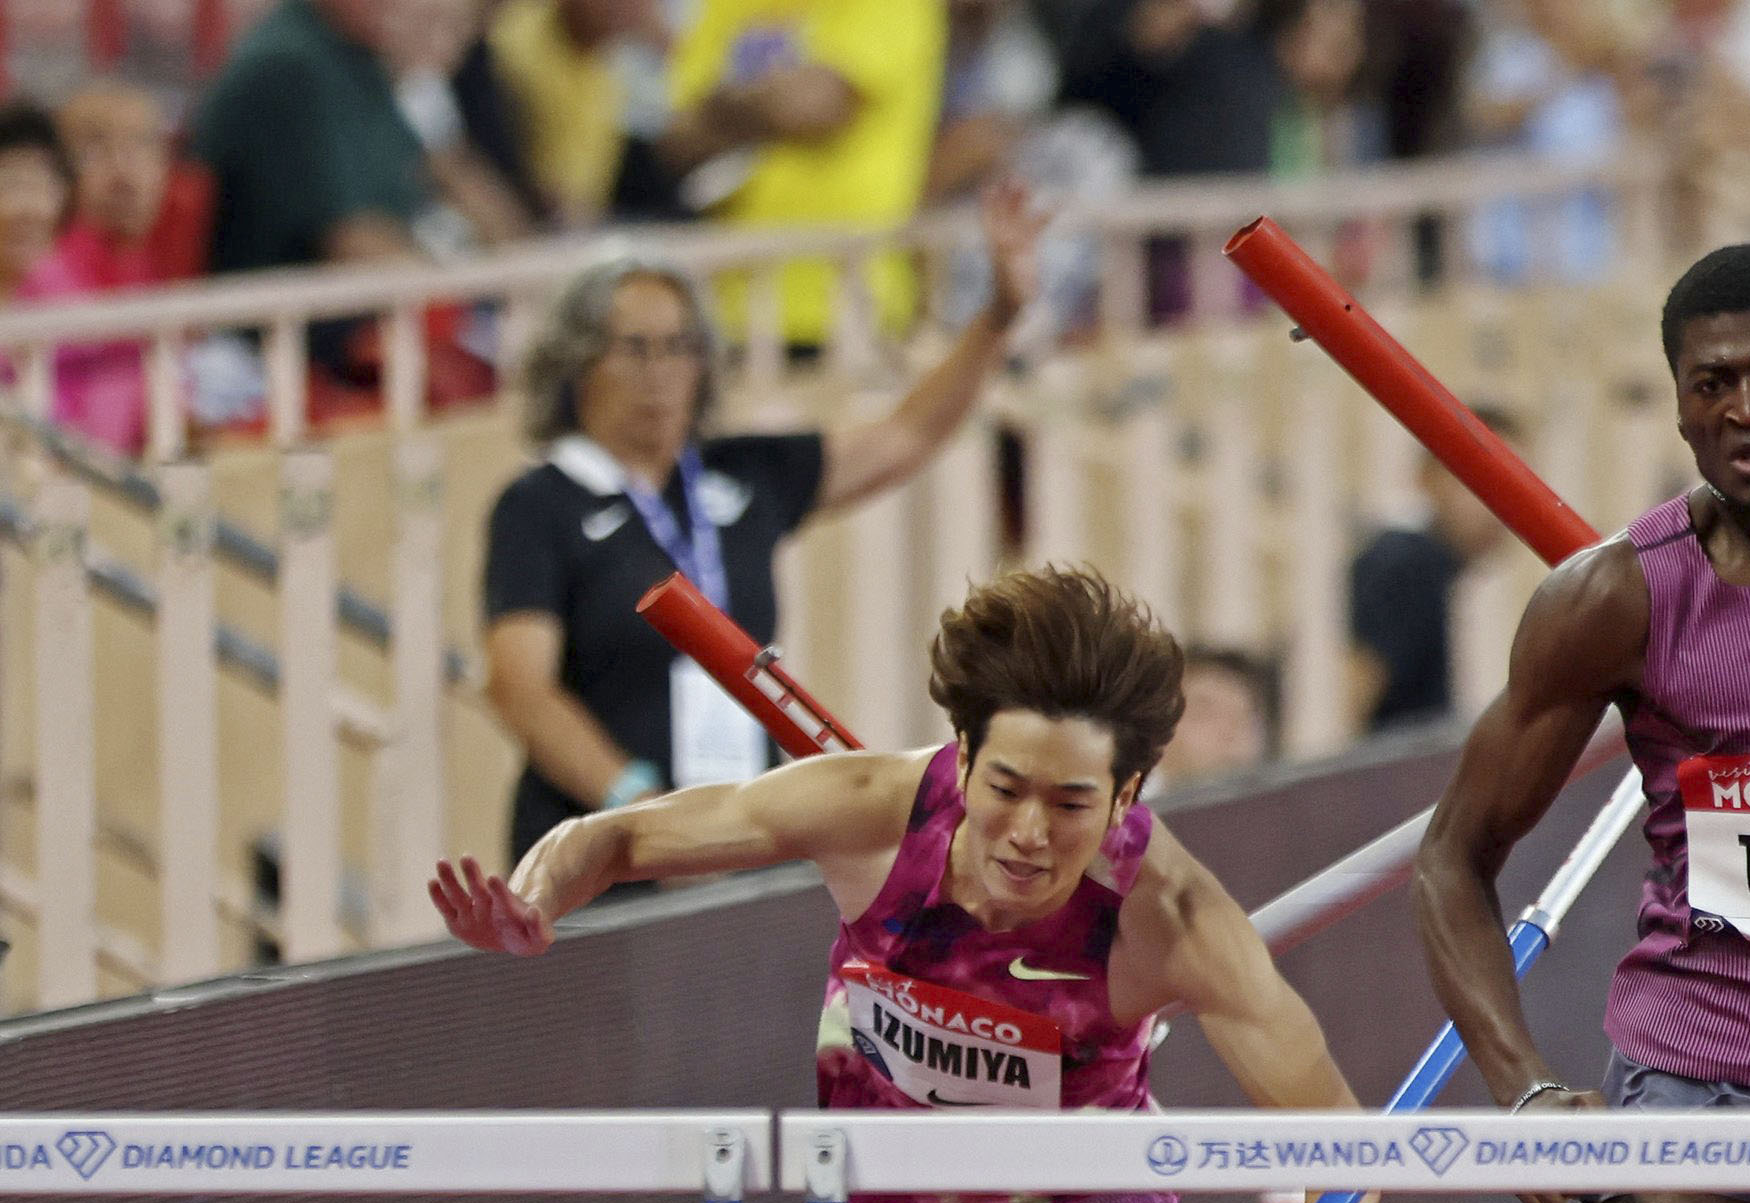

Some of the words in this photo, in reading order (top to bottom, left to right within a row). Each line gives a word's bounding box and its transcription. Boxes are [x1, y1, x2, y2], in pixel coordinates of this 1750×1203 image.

[873, 1002, 1031, 1089] IZUMIYA
[0, 1144, 52, 1169] DA
[122, 1143, 276, 1169] DIAMOND
[285, 1144, 413, 1169] LEAGUE
[1275, 1139, 1405, 1166] WANDA
[1475, 1139, 1630, 1166] DIAMOND
